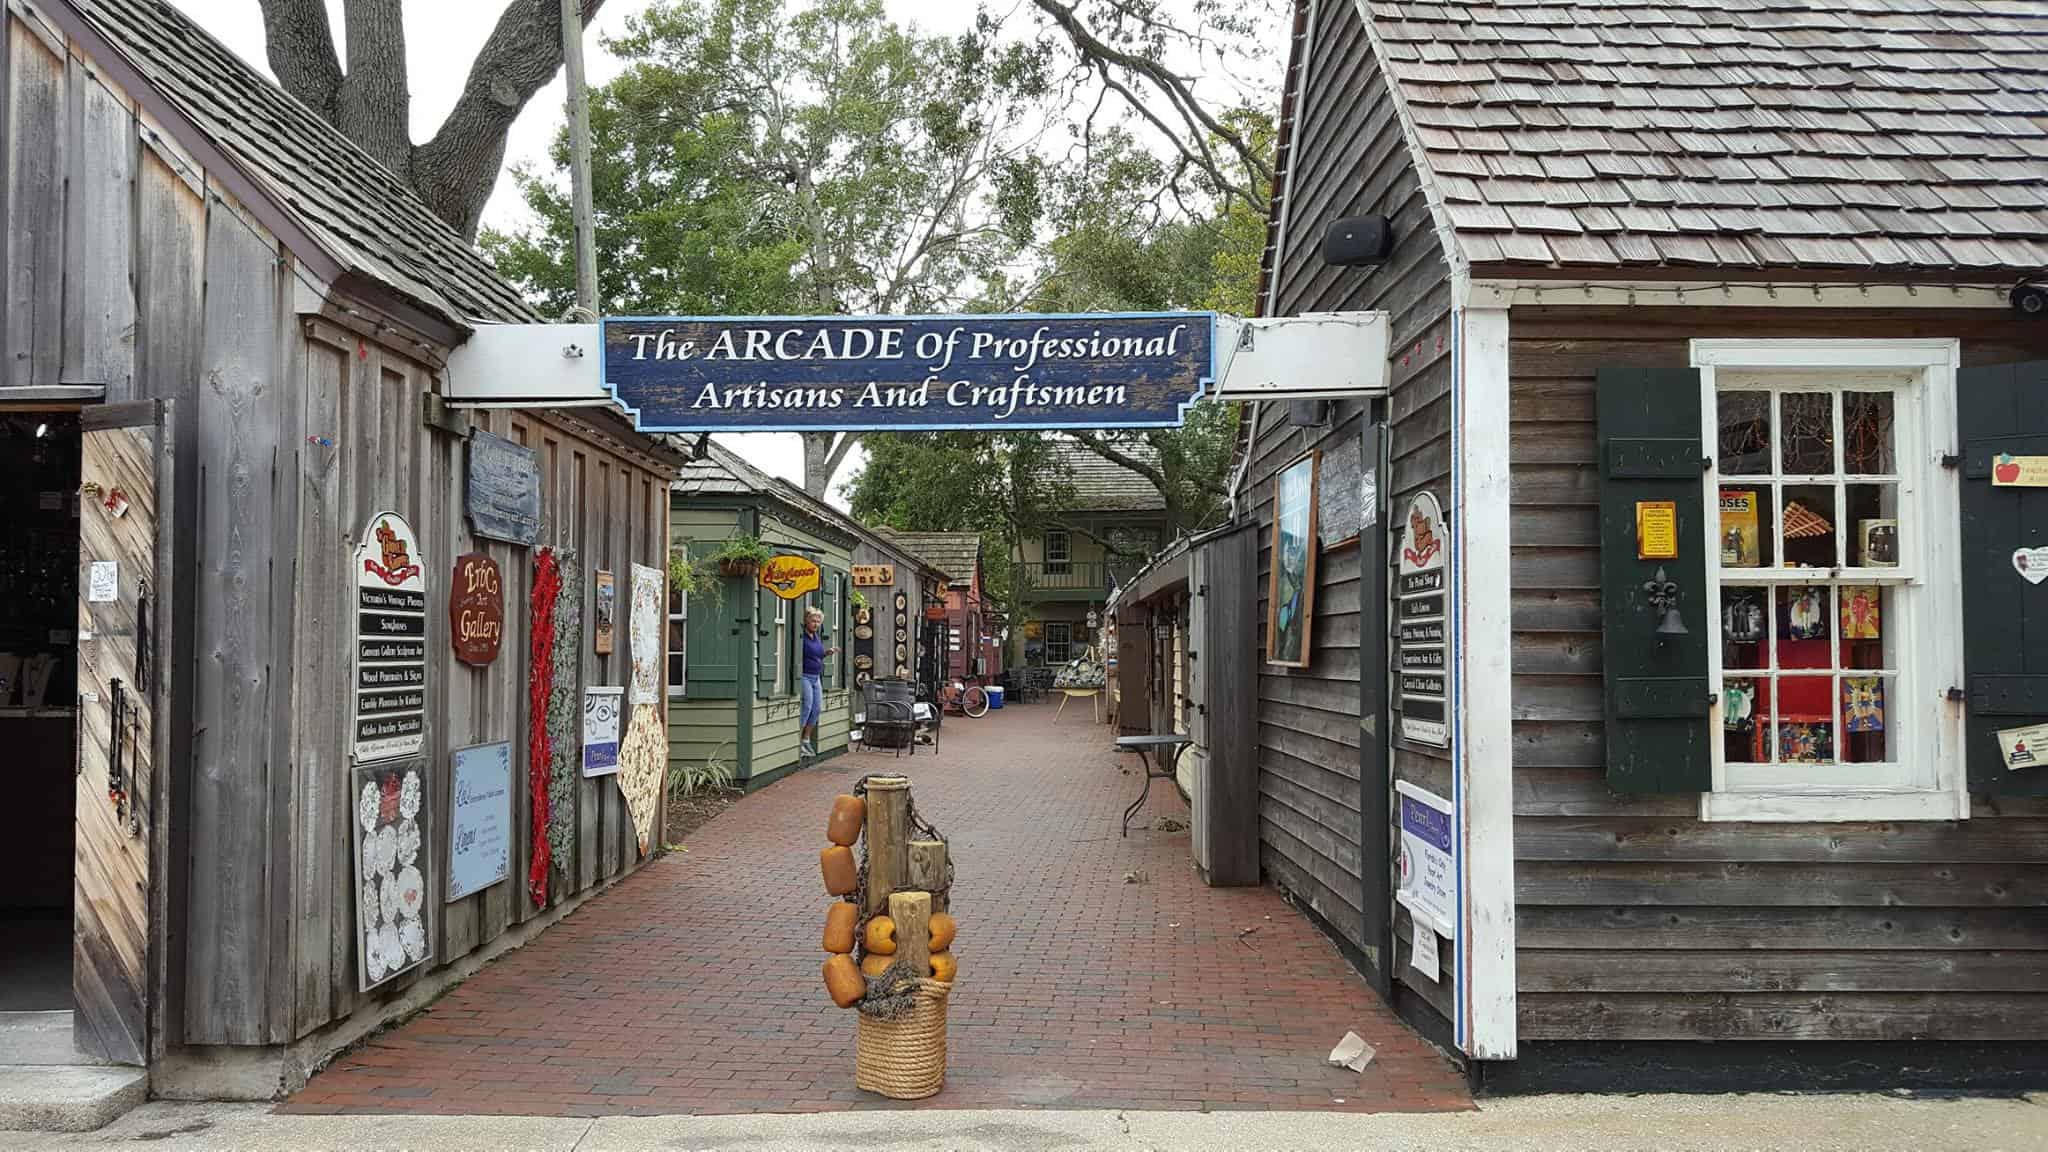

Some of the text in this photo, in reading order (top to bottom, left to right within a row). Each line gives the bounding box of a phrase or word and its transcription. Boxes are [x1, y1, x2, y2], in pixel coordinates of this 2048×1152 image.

[629, 324, 1186, 372] The ARCADE Of Professional
[691, 374, 1127, 419] Artisans And Craftsmen
[461, 609, 500, 646] Gallery
